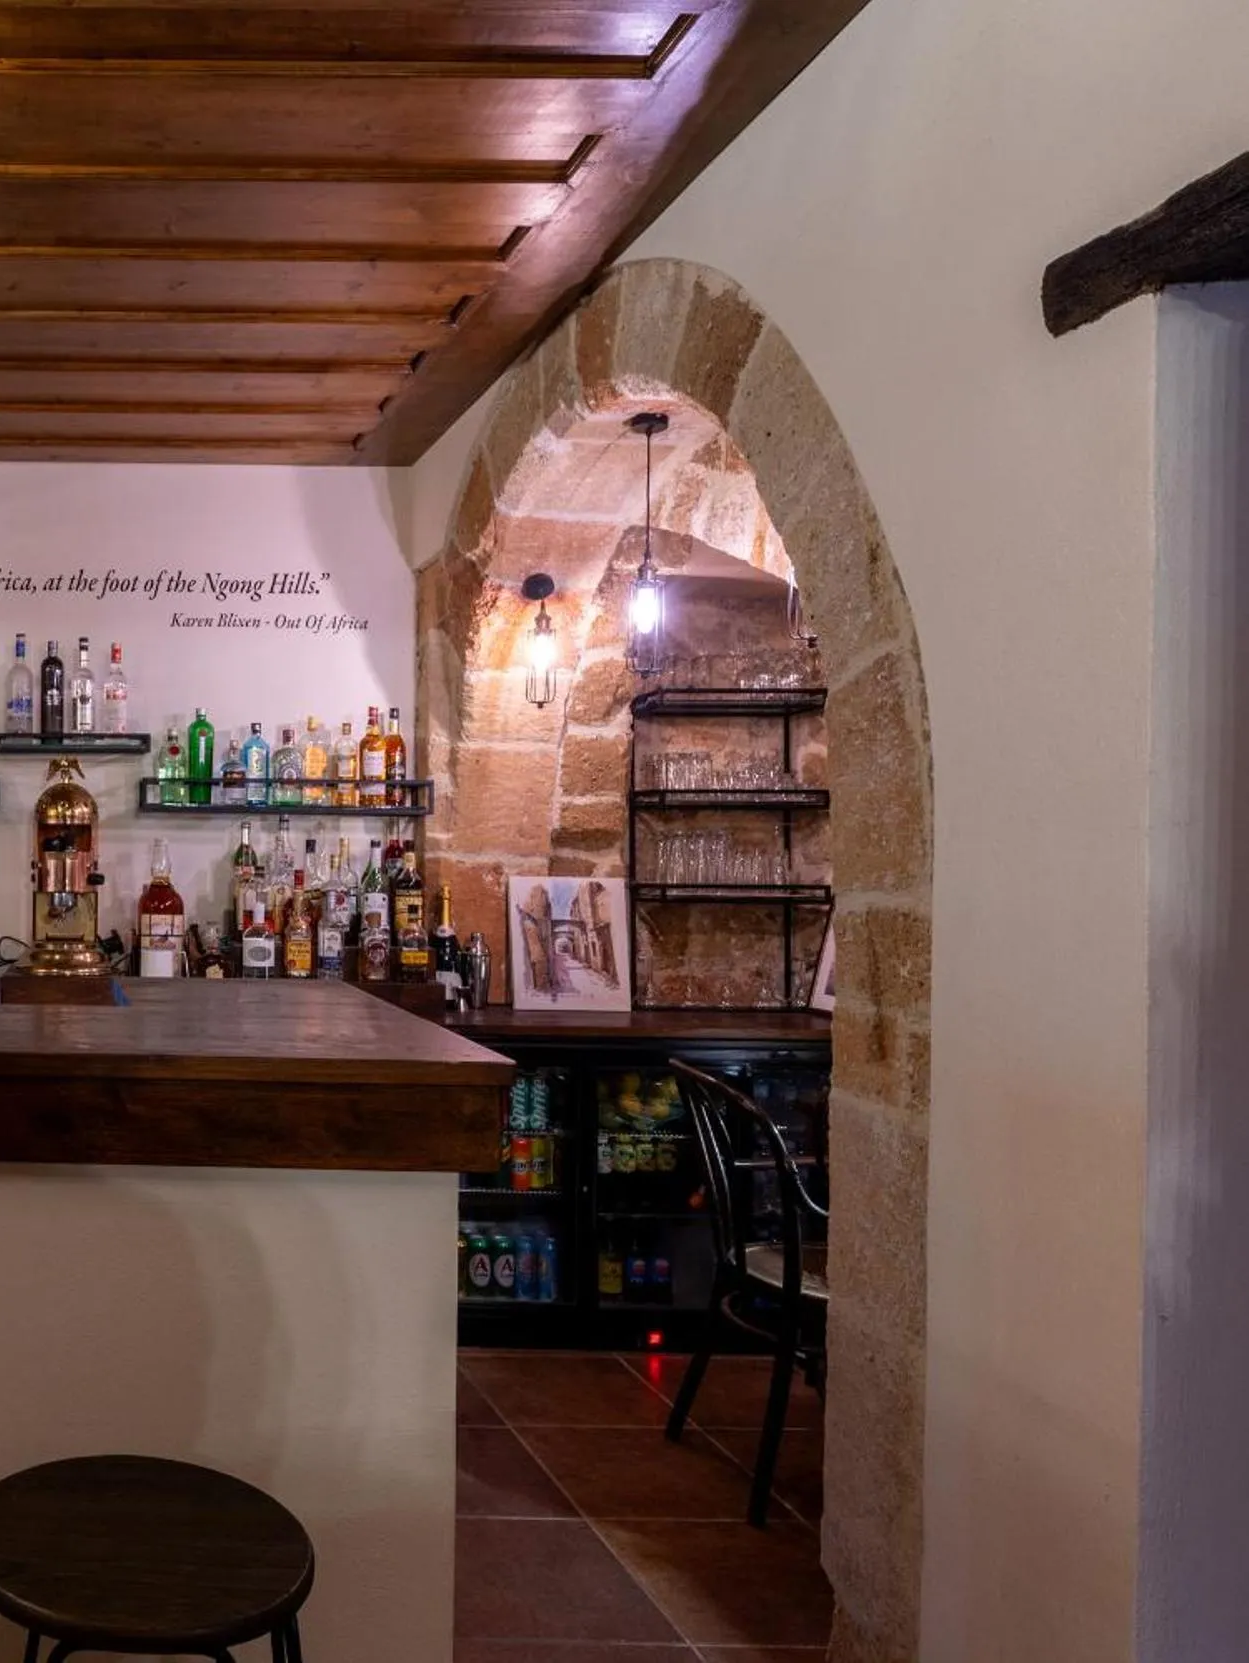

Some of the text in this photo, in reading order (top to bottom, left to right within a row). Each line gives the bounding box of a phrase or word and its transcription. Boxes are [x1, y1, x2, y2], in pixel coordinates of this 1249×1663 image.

[43, 574, 64, 591] at
[68, 568, 98, 592] the
[96, 568, 139, 600] foot
[144, 569, 167, 601] of
[166, 570, 197, 593] the
[201, 572, 265, 602] Ngong
[268, 571, 331, 595] Hills.”
[170, 612, 214, 628] Karen
[217, 612, 261, 628] Blixen
[274, 614, 301, 630] Out
[305, 614, 326, 634] Of
[325, 615, 369, 634] Africa
[510, 1078, 527, 1129] Sprite
